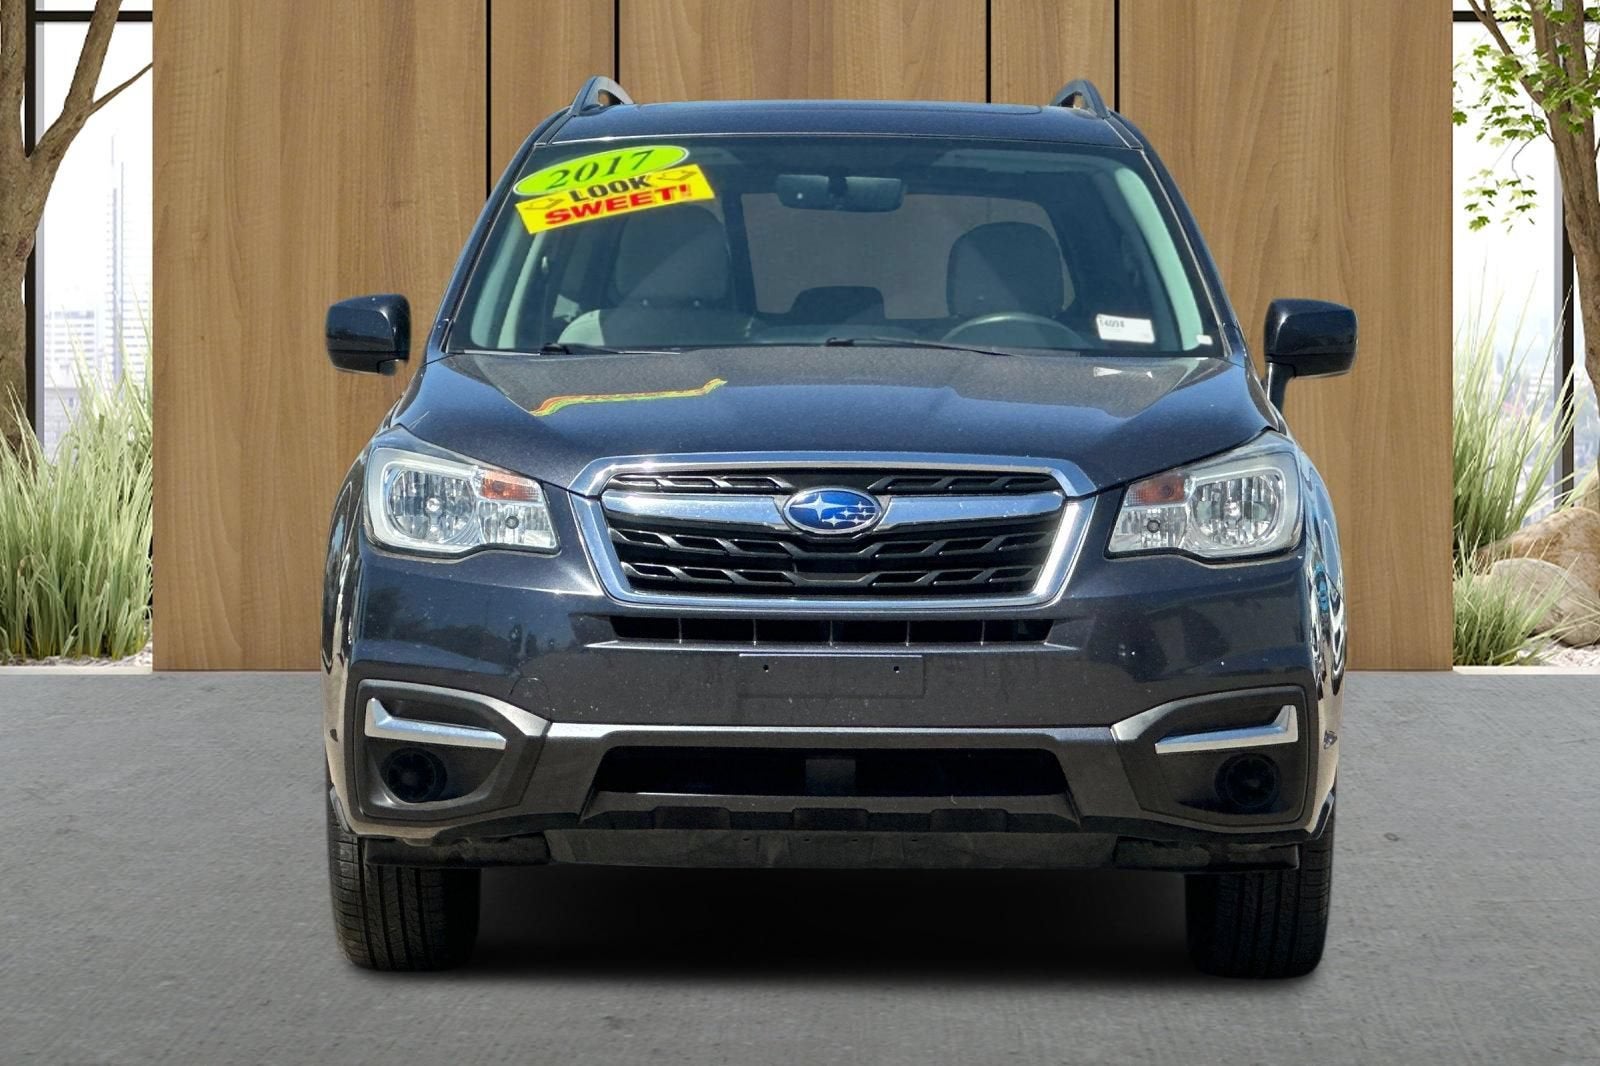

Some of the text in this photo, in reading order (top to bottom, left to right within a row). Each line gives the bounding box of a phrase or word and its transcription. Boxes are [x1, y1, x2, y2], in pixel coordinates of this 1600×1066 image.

[545, 150, 654, 190] 2017
[570, 175, 651, 202] LOOK
[544, 184, 692, 225] SWEET!
